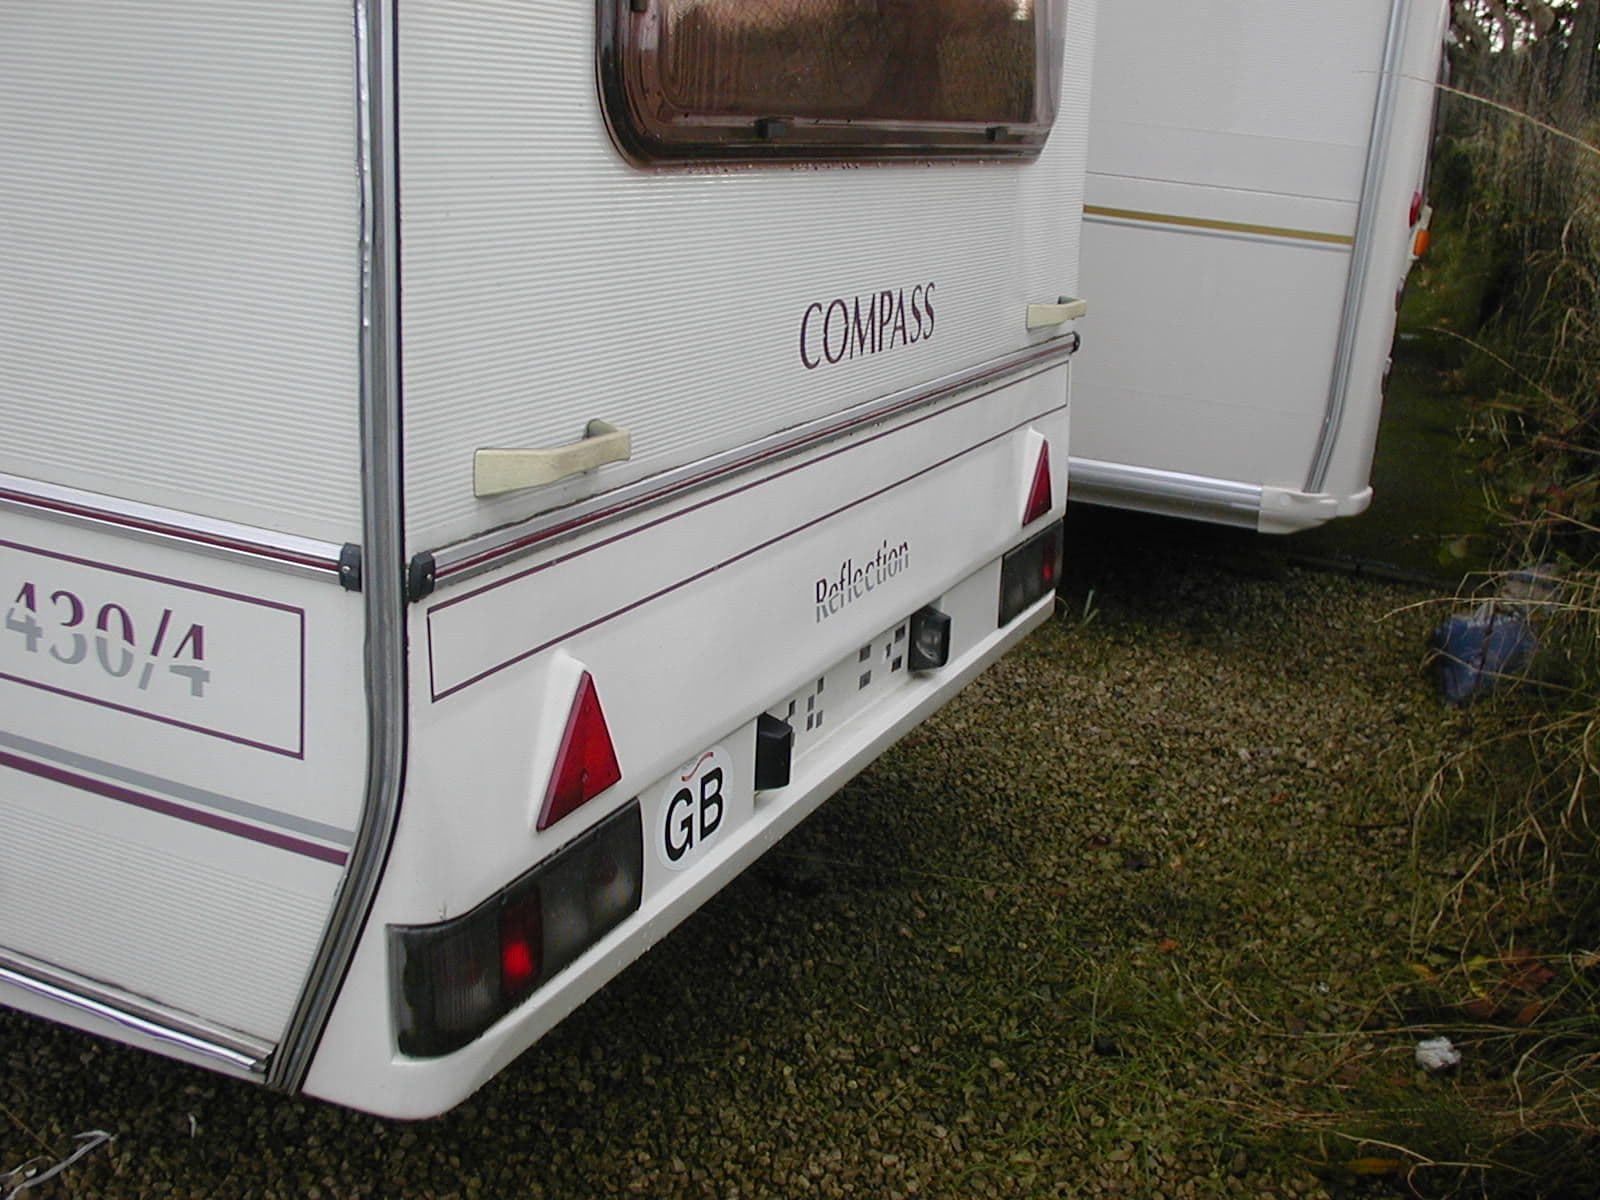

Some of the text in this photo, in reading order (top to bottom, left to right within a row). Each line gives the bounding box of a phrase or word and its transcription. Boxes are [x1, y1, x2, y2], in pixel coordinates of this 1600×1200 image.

[800, 282, 935, 369] COMPASS
[815, 539, 910, 623] Reflection
[5, 582, 211, 698] 430/4
[664, 767, 724, 862] GB
